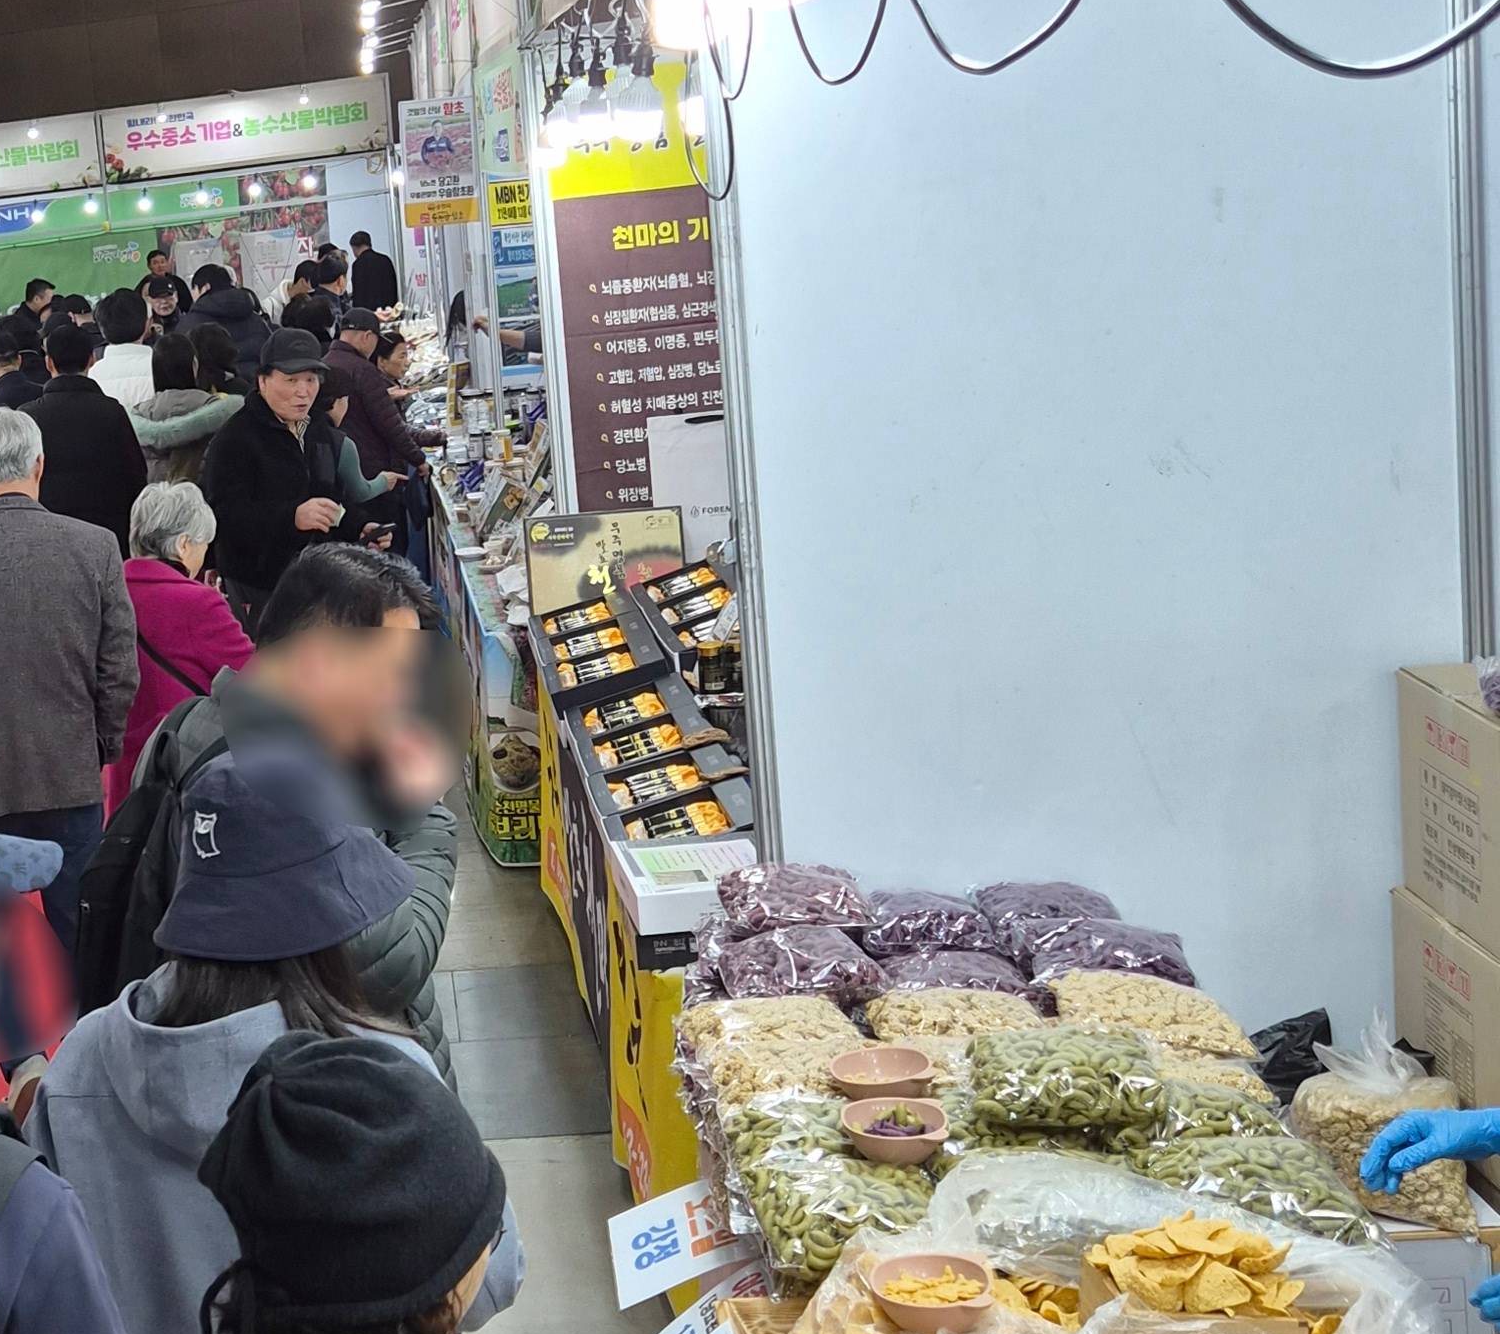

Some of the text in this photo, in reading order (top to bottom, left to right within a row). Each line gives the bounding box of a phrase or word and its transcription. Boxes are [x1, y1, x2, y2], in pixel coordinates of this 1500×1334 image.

[495, 185, 517, 205] MBN
[612, 220, 681, 251] 천마의
[606, 329, 720, 355] 어지럼증, 이명증, 편두
[645, 391, 698, 411] 치매증상의
[613, 427, 649, 445] 경련환
[615, 456, 647, 474] 당뇨병
[618, 486, 653, 503] 위장병,
[632, 1218, 681, 1271] 강정
